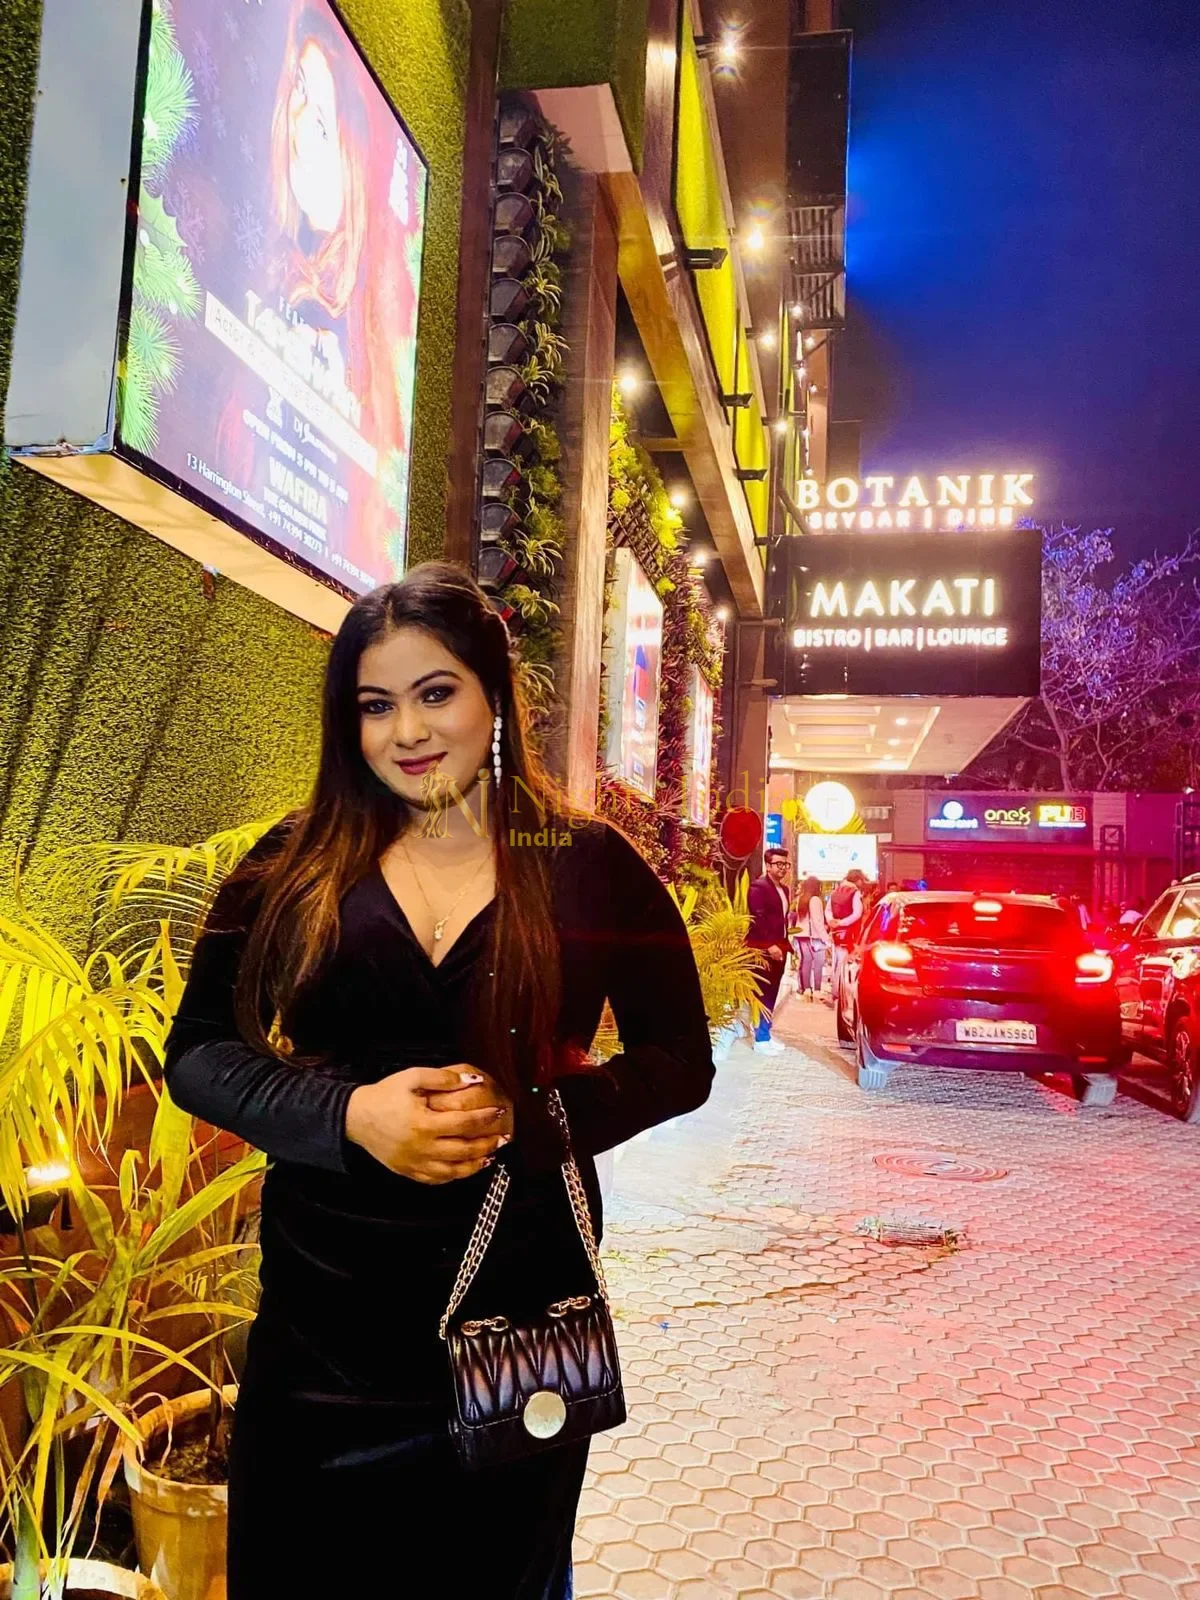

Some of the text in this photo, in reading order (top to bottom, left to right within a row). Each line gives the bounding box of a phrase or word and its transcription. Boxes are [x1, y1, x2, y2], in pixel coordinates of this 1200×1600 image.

[186, 452, 198, 471] 13
[199, 459, 242, 501] Harrington
[796, 474, 1034, 509] BOTANIK
[810, 578, 996, 618] MAKATI
